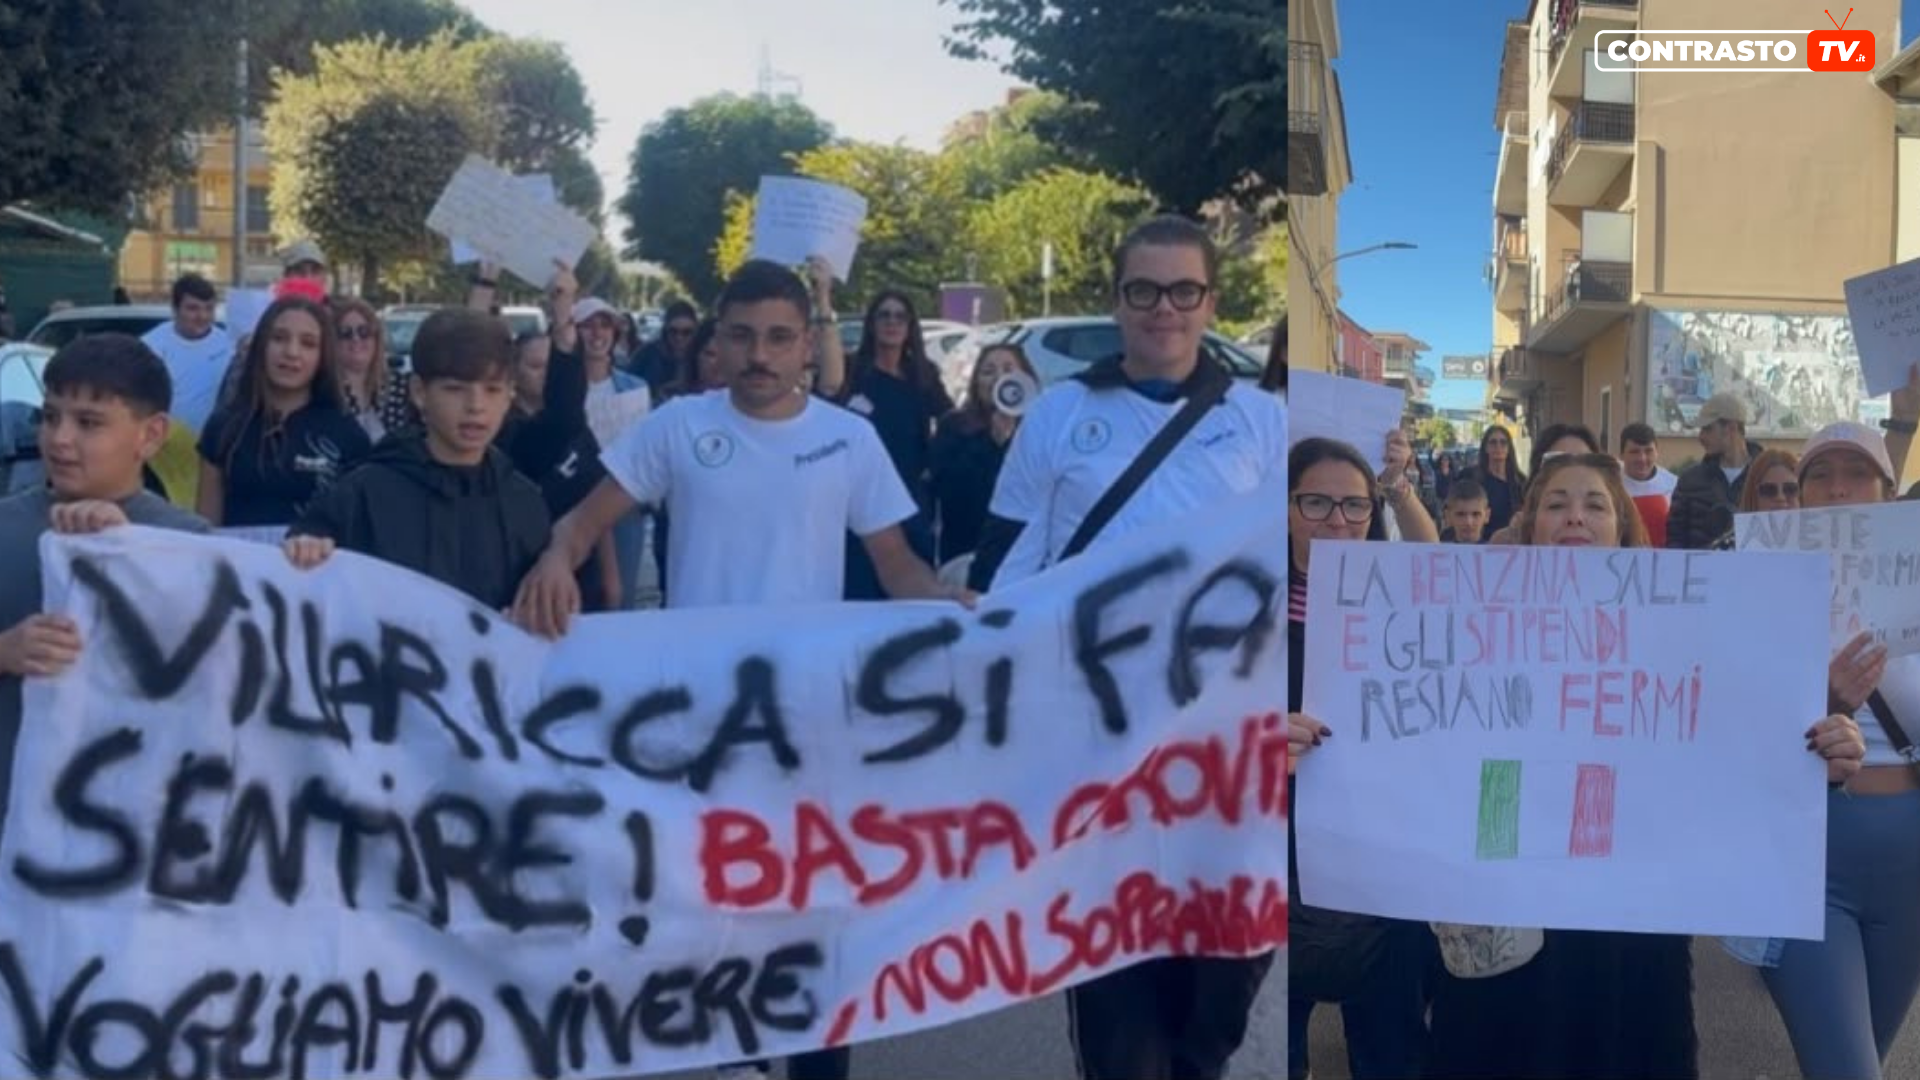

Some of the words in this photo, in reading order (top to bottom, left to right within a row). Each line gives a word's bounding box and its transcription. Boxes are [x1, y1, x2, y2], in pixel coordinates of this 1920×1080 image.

[1336, 551, 1390, 608] LA
[1410, 547, 1581, 606] BENZINA
[1604, 551, 1711, 608] SALE
[1071, 547, 1278, 737] FA
[1342, 612, 1370, 673] E
[699, 802, 1037, 909] BASTA
[874, 911, 1029, 1022] NON
